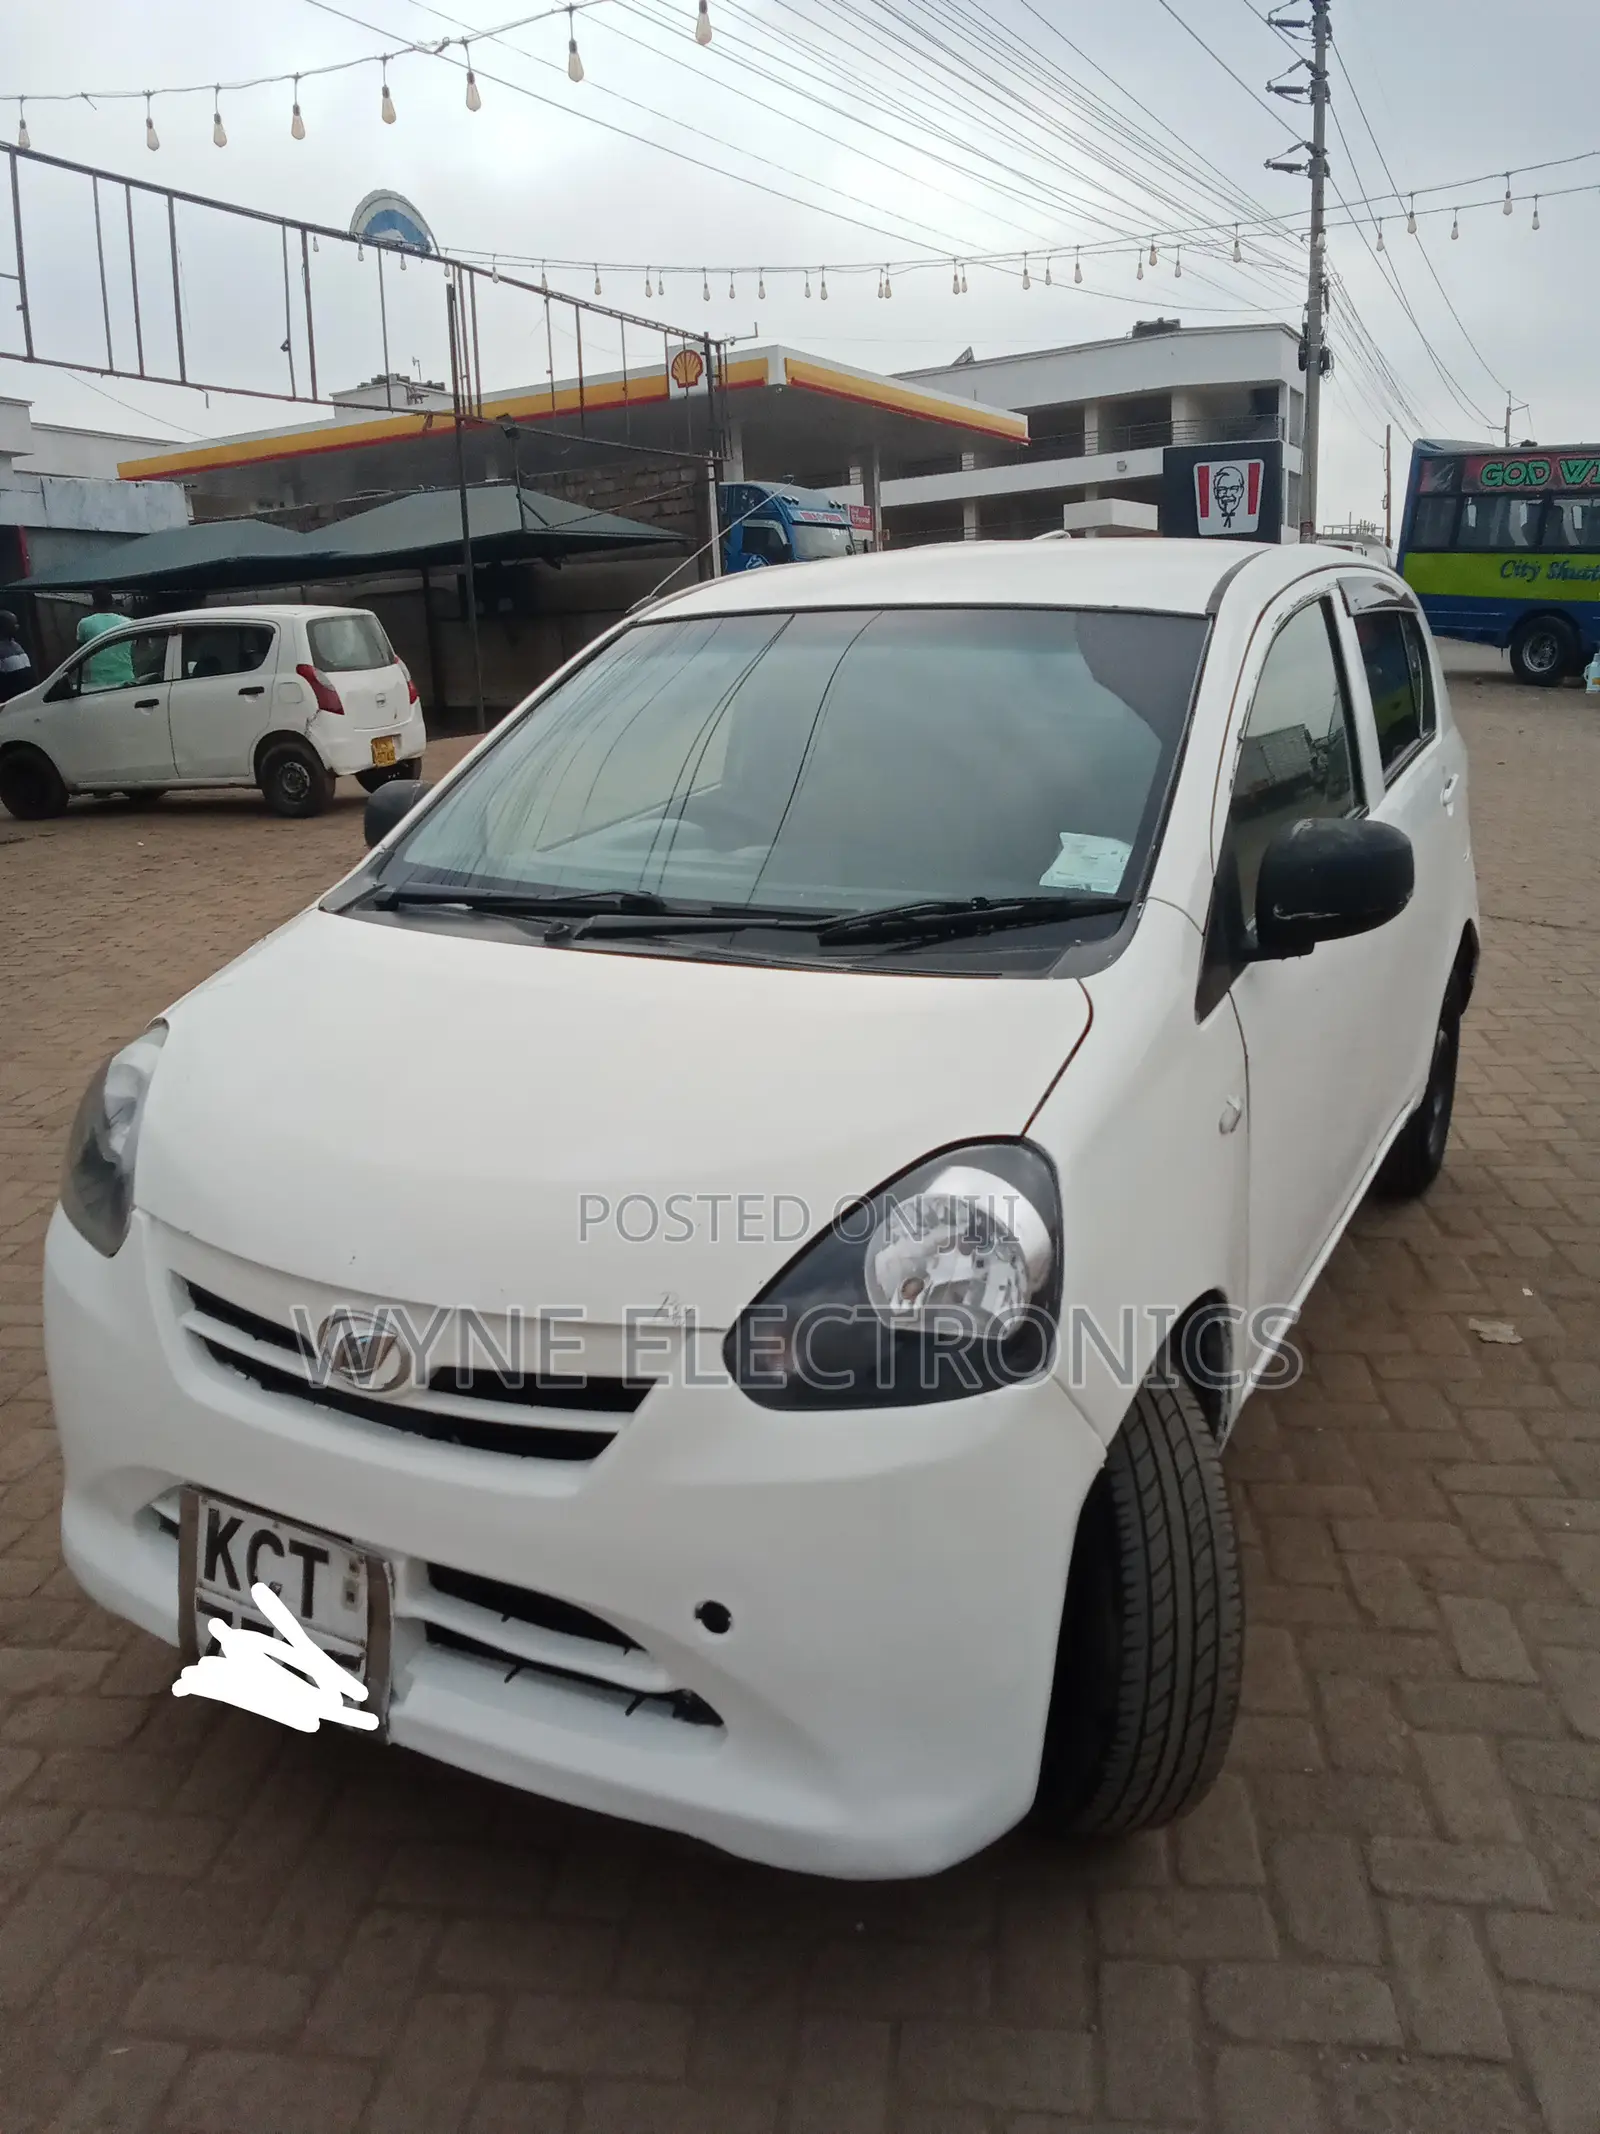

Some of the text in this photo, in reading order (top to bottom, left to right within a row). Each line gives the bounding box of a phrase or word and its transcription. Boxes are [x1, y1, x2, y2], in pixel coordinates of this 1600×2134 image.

[1481, 460, 1551, 487] GOD
[1500, 559, 1541, 583] City
[203, 1508, 330, 1619] KCT
